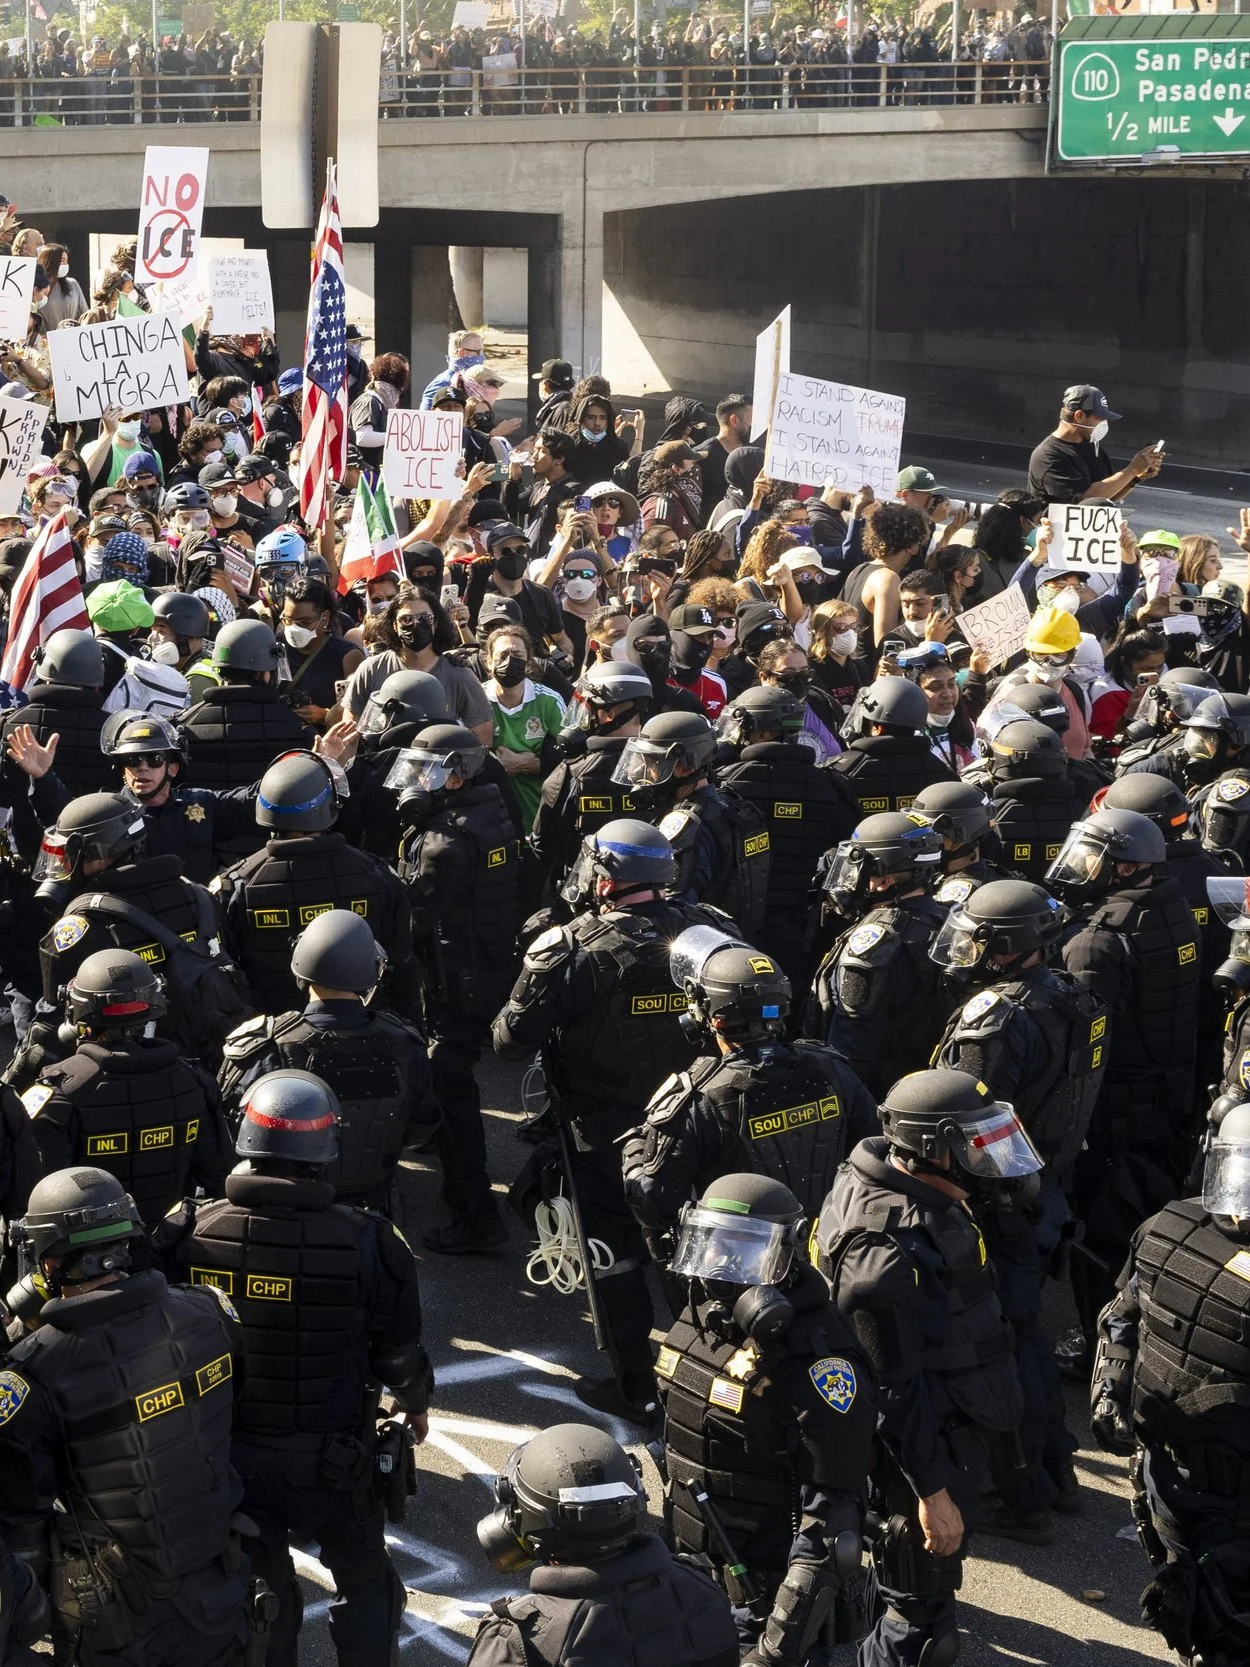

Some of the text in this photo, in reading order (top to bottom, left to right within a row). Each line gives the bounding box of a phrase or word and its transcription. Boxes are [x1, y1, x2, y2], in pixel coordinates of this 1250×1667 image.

[1135, 48, 1181, 71] San
[1083, 70, 1108, 91] 110
[1106, 112, 1191, 141] 1/2 MILE
[145, 173, 200, 212] NO
[142, 226, 196, 260] ICE
[79, 320, 180, 363] CHINGA
[101, 359, 130, 384] LA
[76, 366, 180, 415] MIGRA
[781, 375, 905, 417] I STAND AGAINST
[777, 400, 903, 441] RACISM TRUMP
[386, 416, 462, 456] ABOLISH
[772, 428, 899, 465] I STAND AGAINST
[403, 457, 443, 490] ICE
[771, 456, 894, 493] HATRED ICE
[1064, 506, 1119, 535] FUCK
[1066, 536, 1118, 566] ICE
[700, 609, 712, 624] LA
[962, 591, 1026, 638] BROWN
[994, 623, 1012, 648] IS
[589, 800, 606, 809] INL
[778, 806, 799, 816] CHP
[862, 801, 885, 810] SOU
[1017, 848, 1028, 856] LB
[263, 914, 282, 924] INL
[140, 949, 159, 961] INL
[1181, 947, 1194, 960] CHP
[637, 999, 662, 1010] SOU
[754, 1107, 813, 1134] SOU CHP
[97, 1131, 169, 1151] INL CHP
[199, 1274, 285, 1296] INL CHP
[813, 1359, 847, 1373] CALIFORNIA
[143, 1390, 177, 1415] CHP
